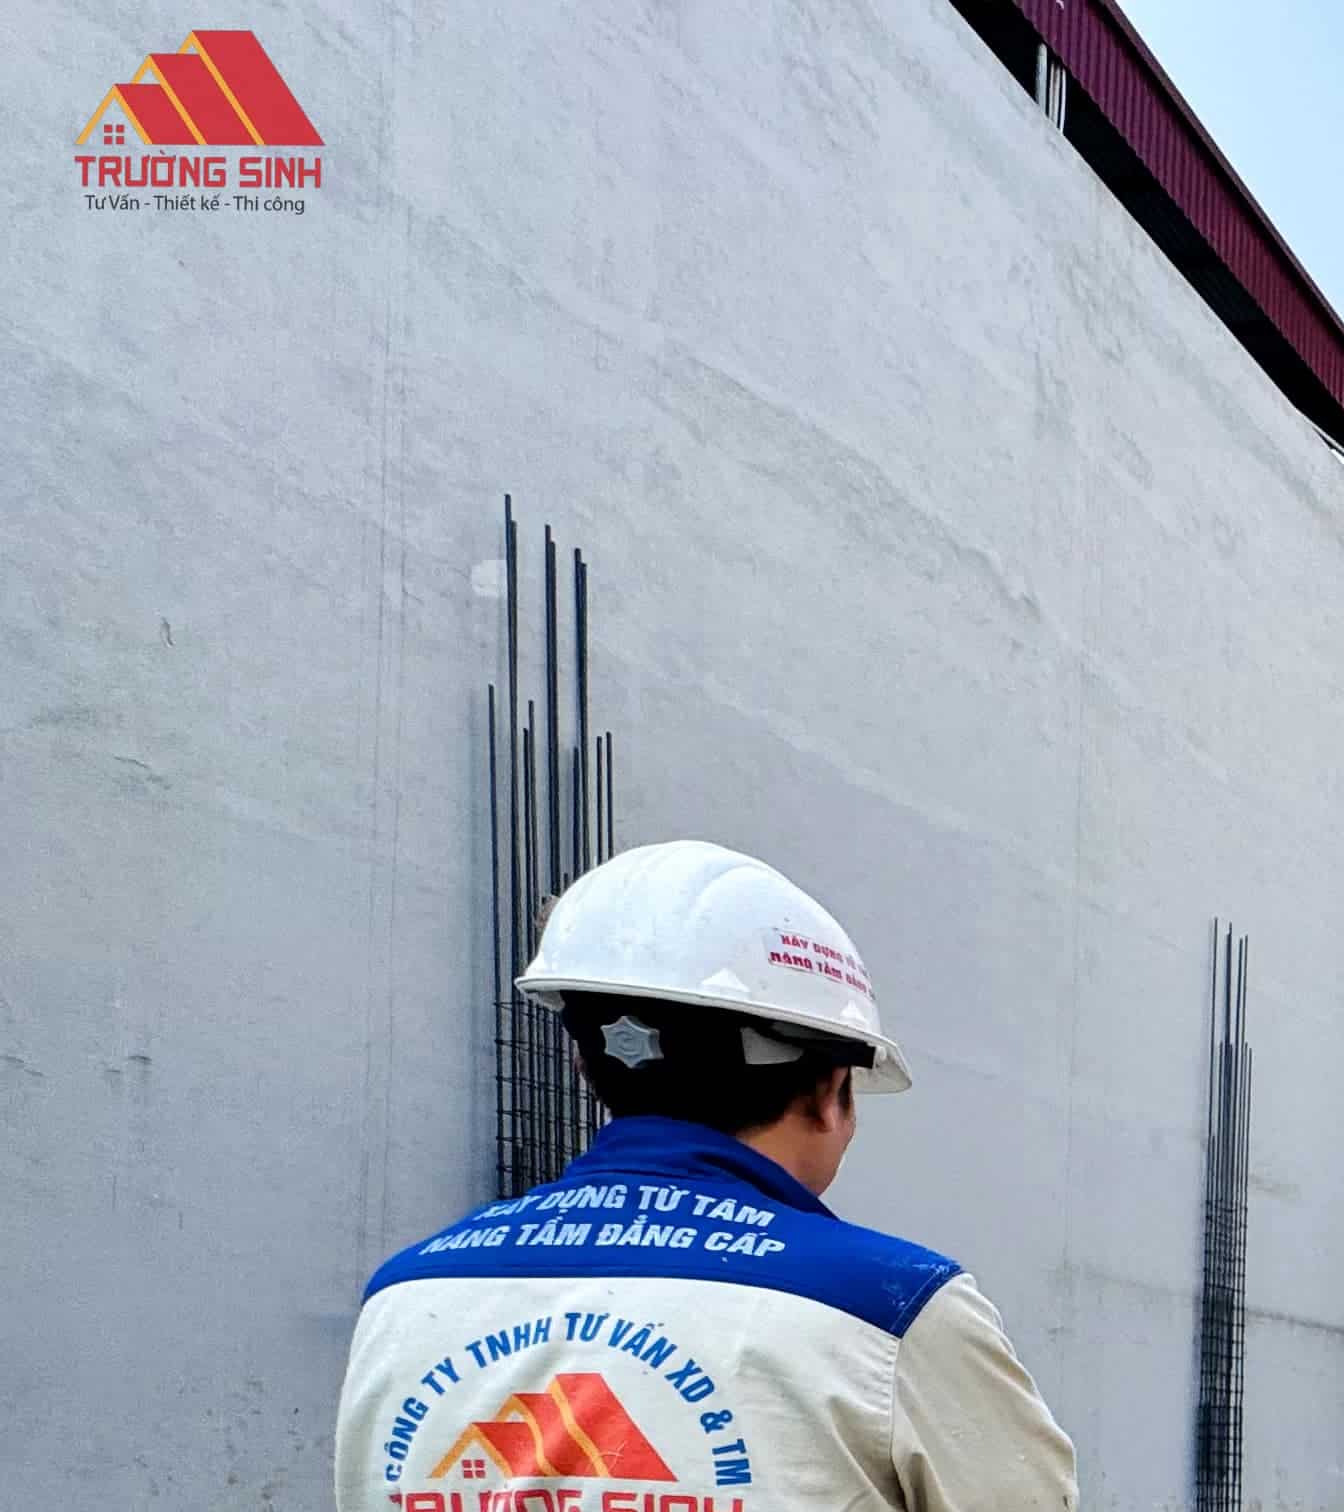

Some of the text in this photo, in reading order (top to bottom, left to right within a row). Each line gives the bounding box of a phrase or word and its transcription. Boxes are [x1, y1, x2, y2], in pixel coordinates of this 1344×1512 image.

[536, 1184, 628, 1213] DỰNG
[639, 1185, 689, 1212] TỪ
[692, 1191, 775, 1227] TÂM
[515, 1215, 591, 1247] TẦM
[596, 1214, 697, 1249] ĐẲNG
[704, 1231, 785, 1257] CẤP
[385, 1312, 752, 1487] CÔNG TY TNHH TƯ VẤN XD & TM
